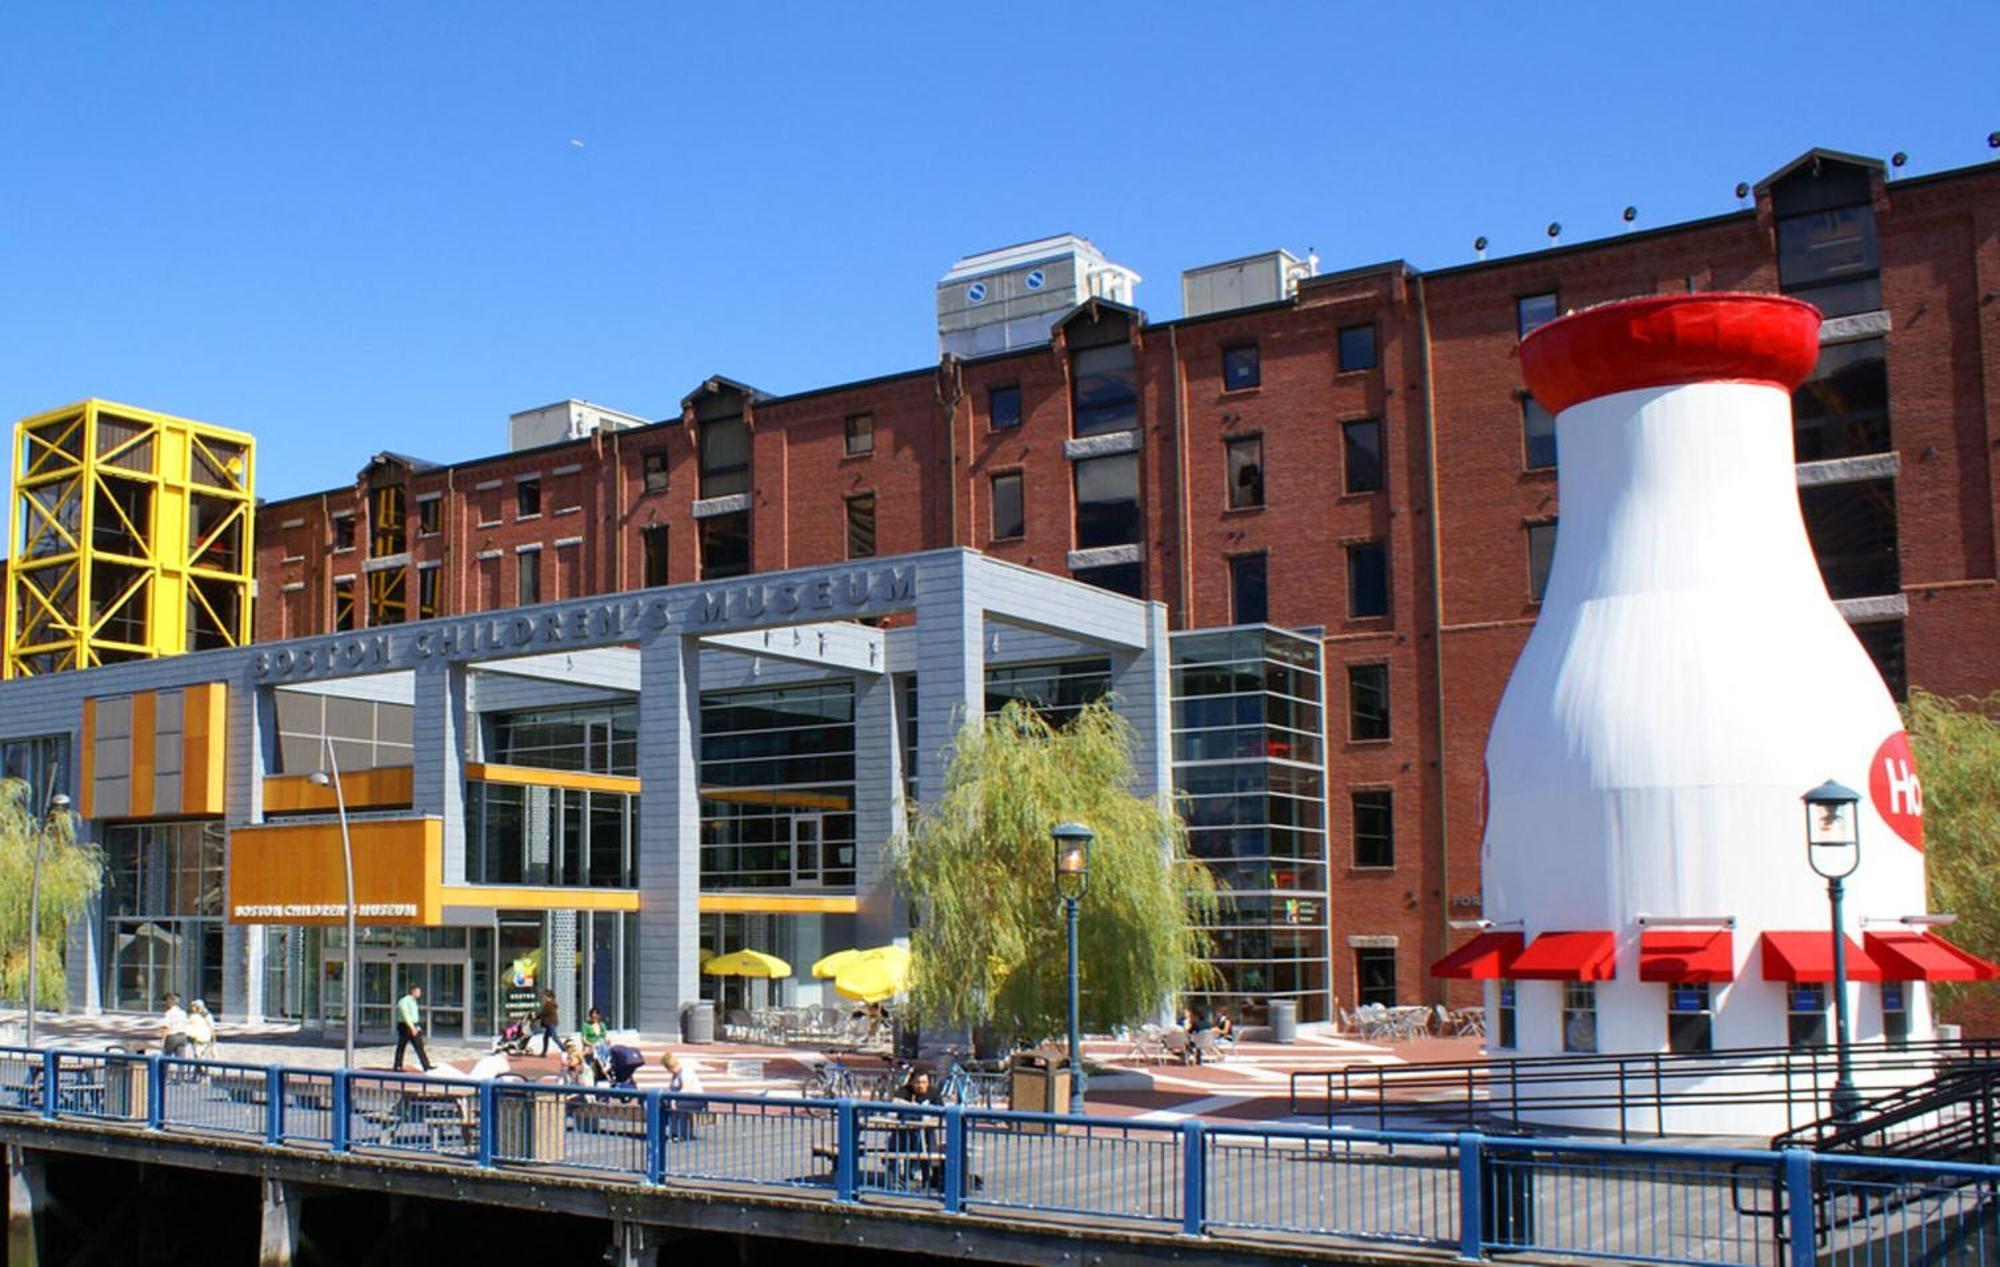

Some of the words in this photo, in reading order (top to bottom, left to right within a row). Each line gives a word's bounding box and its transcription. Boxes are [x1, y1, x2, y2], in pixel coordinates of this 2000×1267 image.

[253, 636, 393, 678] BOSTON
[415, 602, 671, 660] CHILDREN'S
[700, 564, 916, 624] MUSEUM
[234, 904, 283, 917] BOSTON
[284, 904, 357, 917] CHILDREN
[358, 904, 417, 917] MUSEUM
